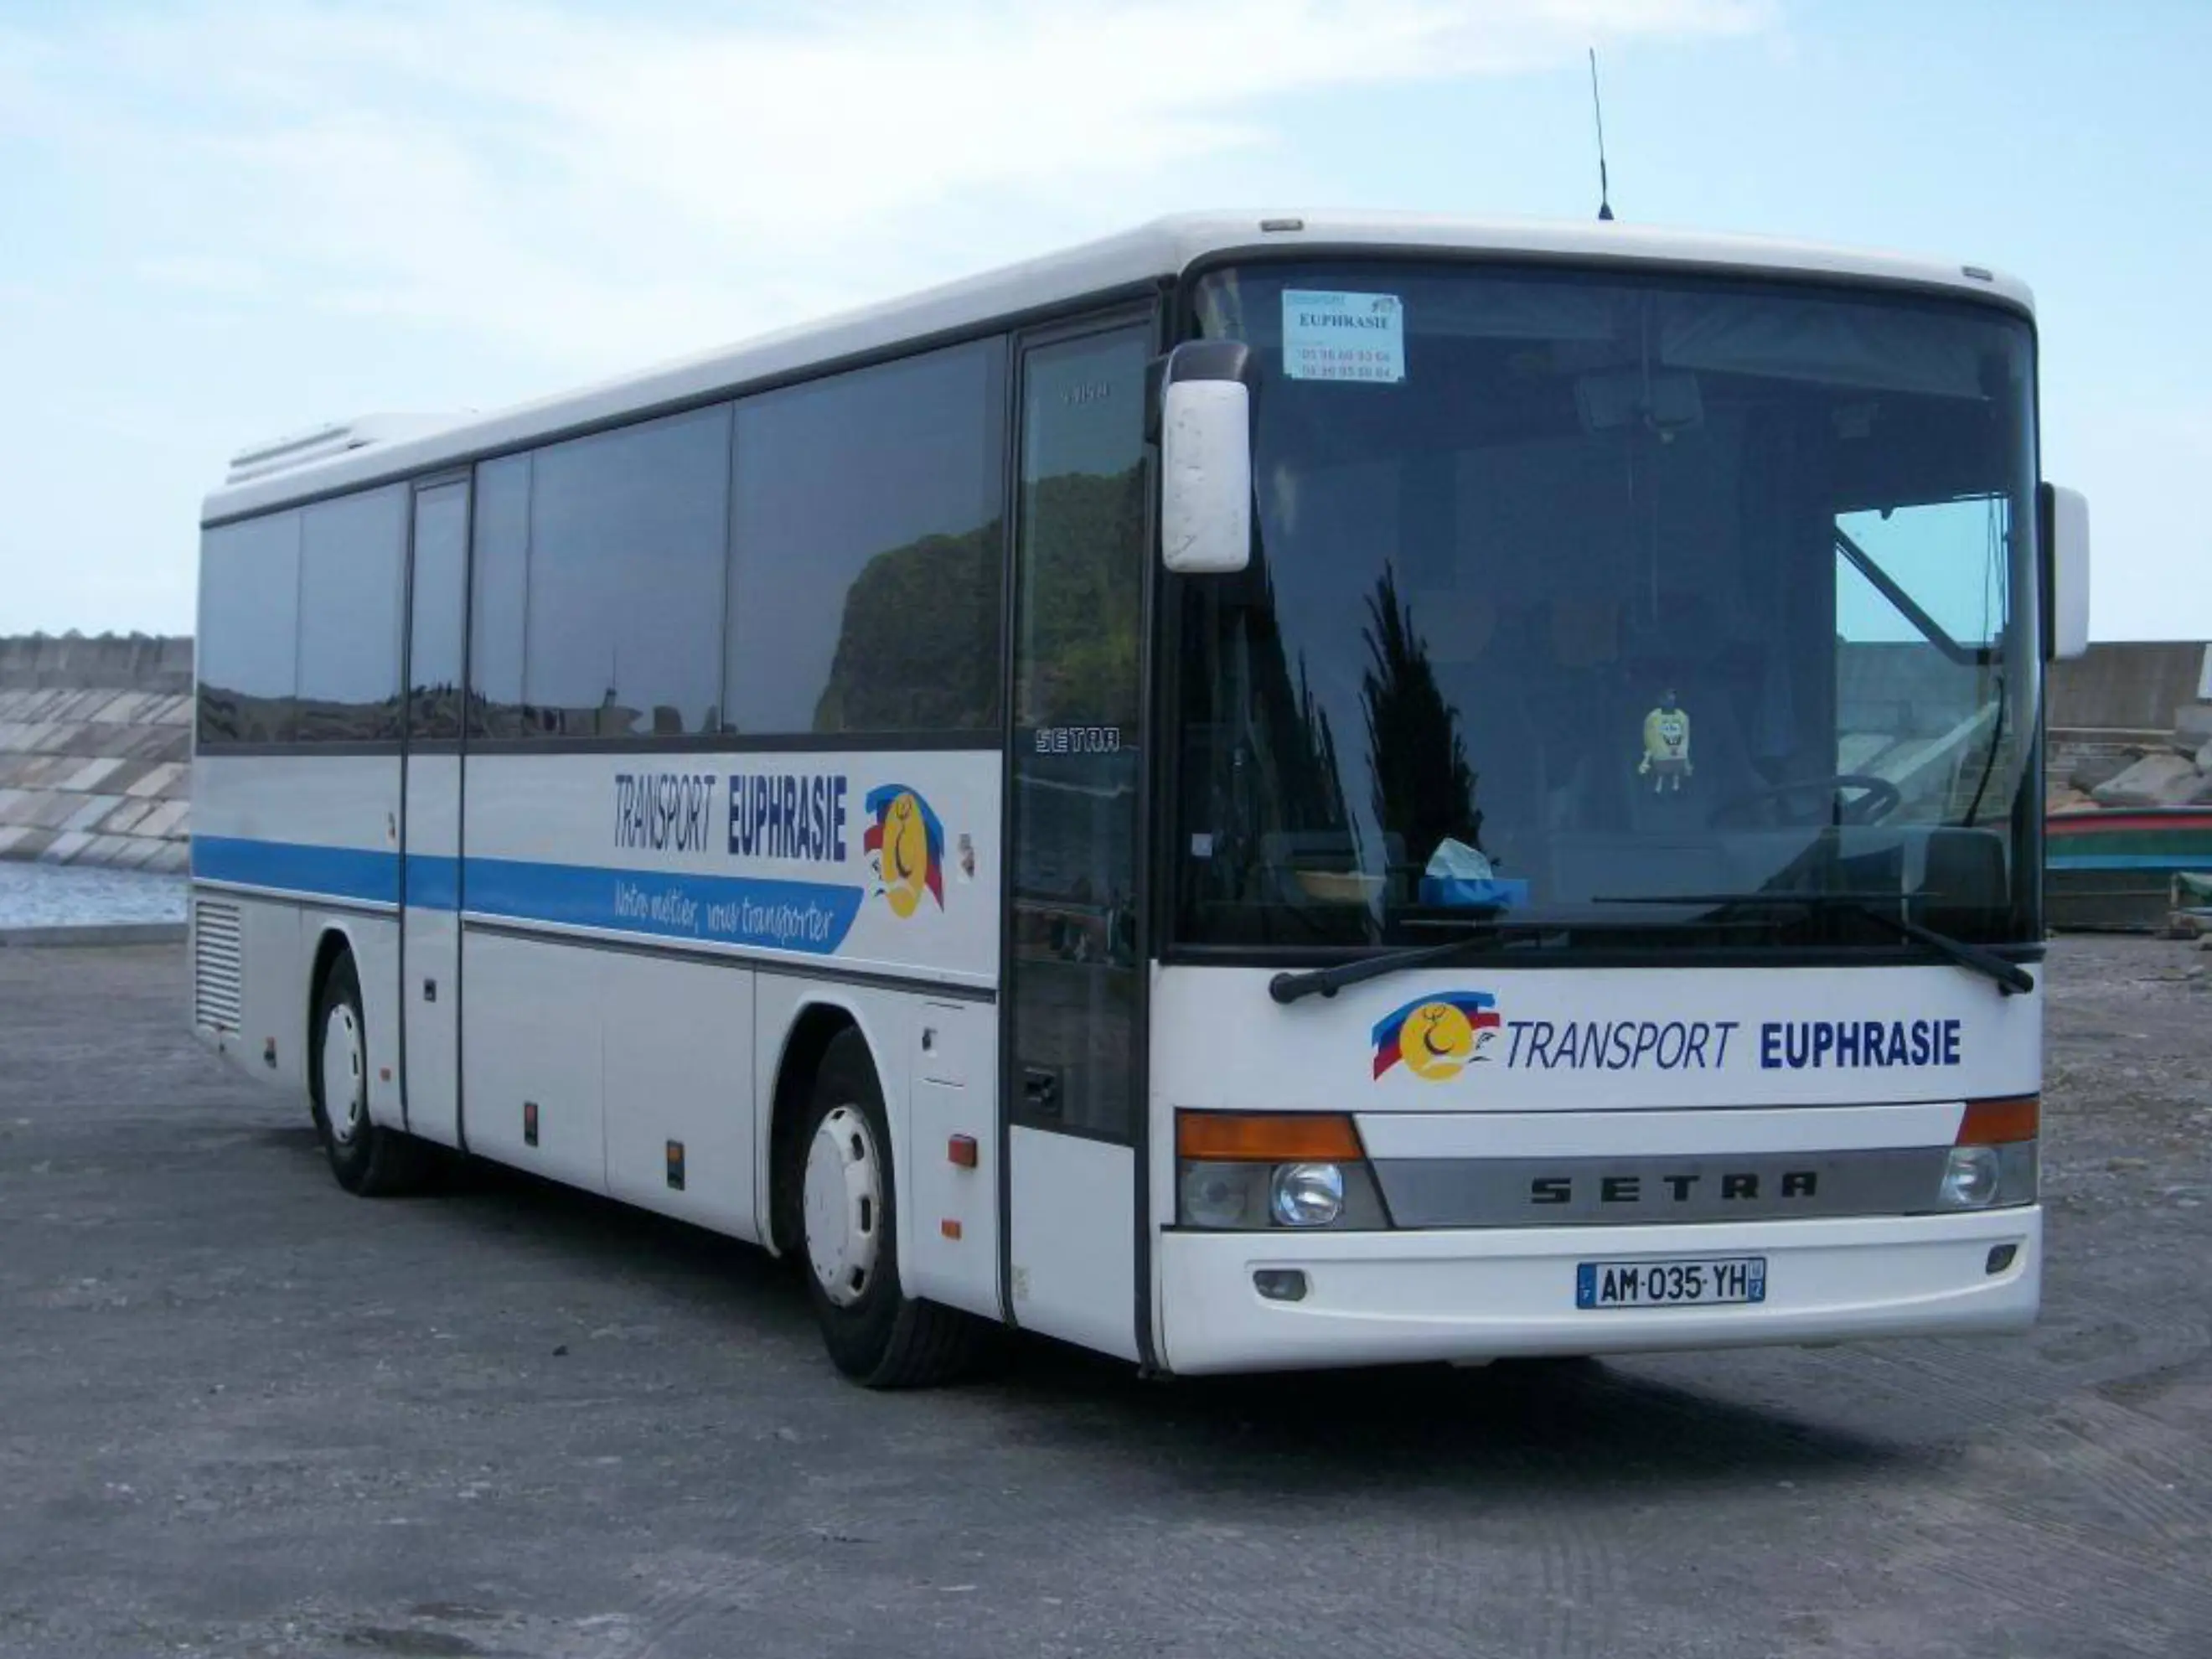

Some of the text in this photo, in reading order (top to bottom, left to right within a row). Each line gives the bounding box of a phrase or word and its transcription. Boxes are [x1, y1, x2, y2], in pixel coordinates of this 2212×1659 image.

[1300, 313, 1389, 330] EUPHRASIE
[1036, 726, 1120, 752] SETRA
[614, 774, 848, 862] TRANSPORT EUPHRASIE
[742, 897, 834, 948] transporter
[1506, 1019, 1961, 1070] TRANSPORT EUPHRASIE
[1530, 1171, 1817, 1205] SETRA
